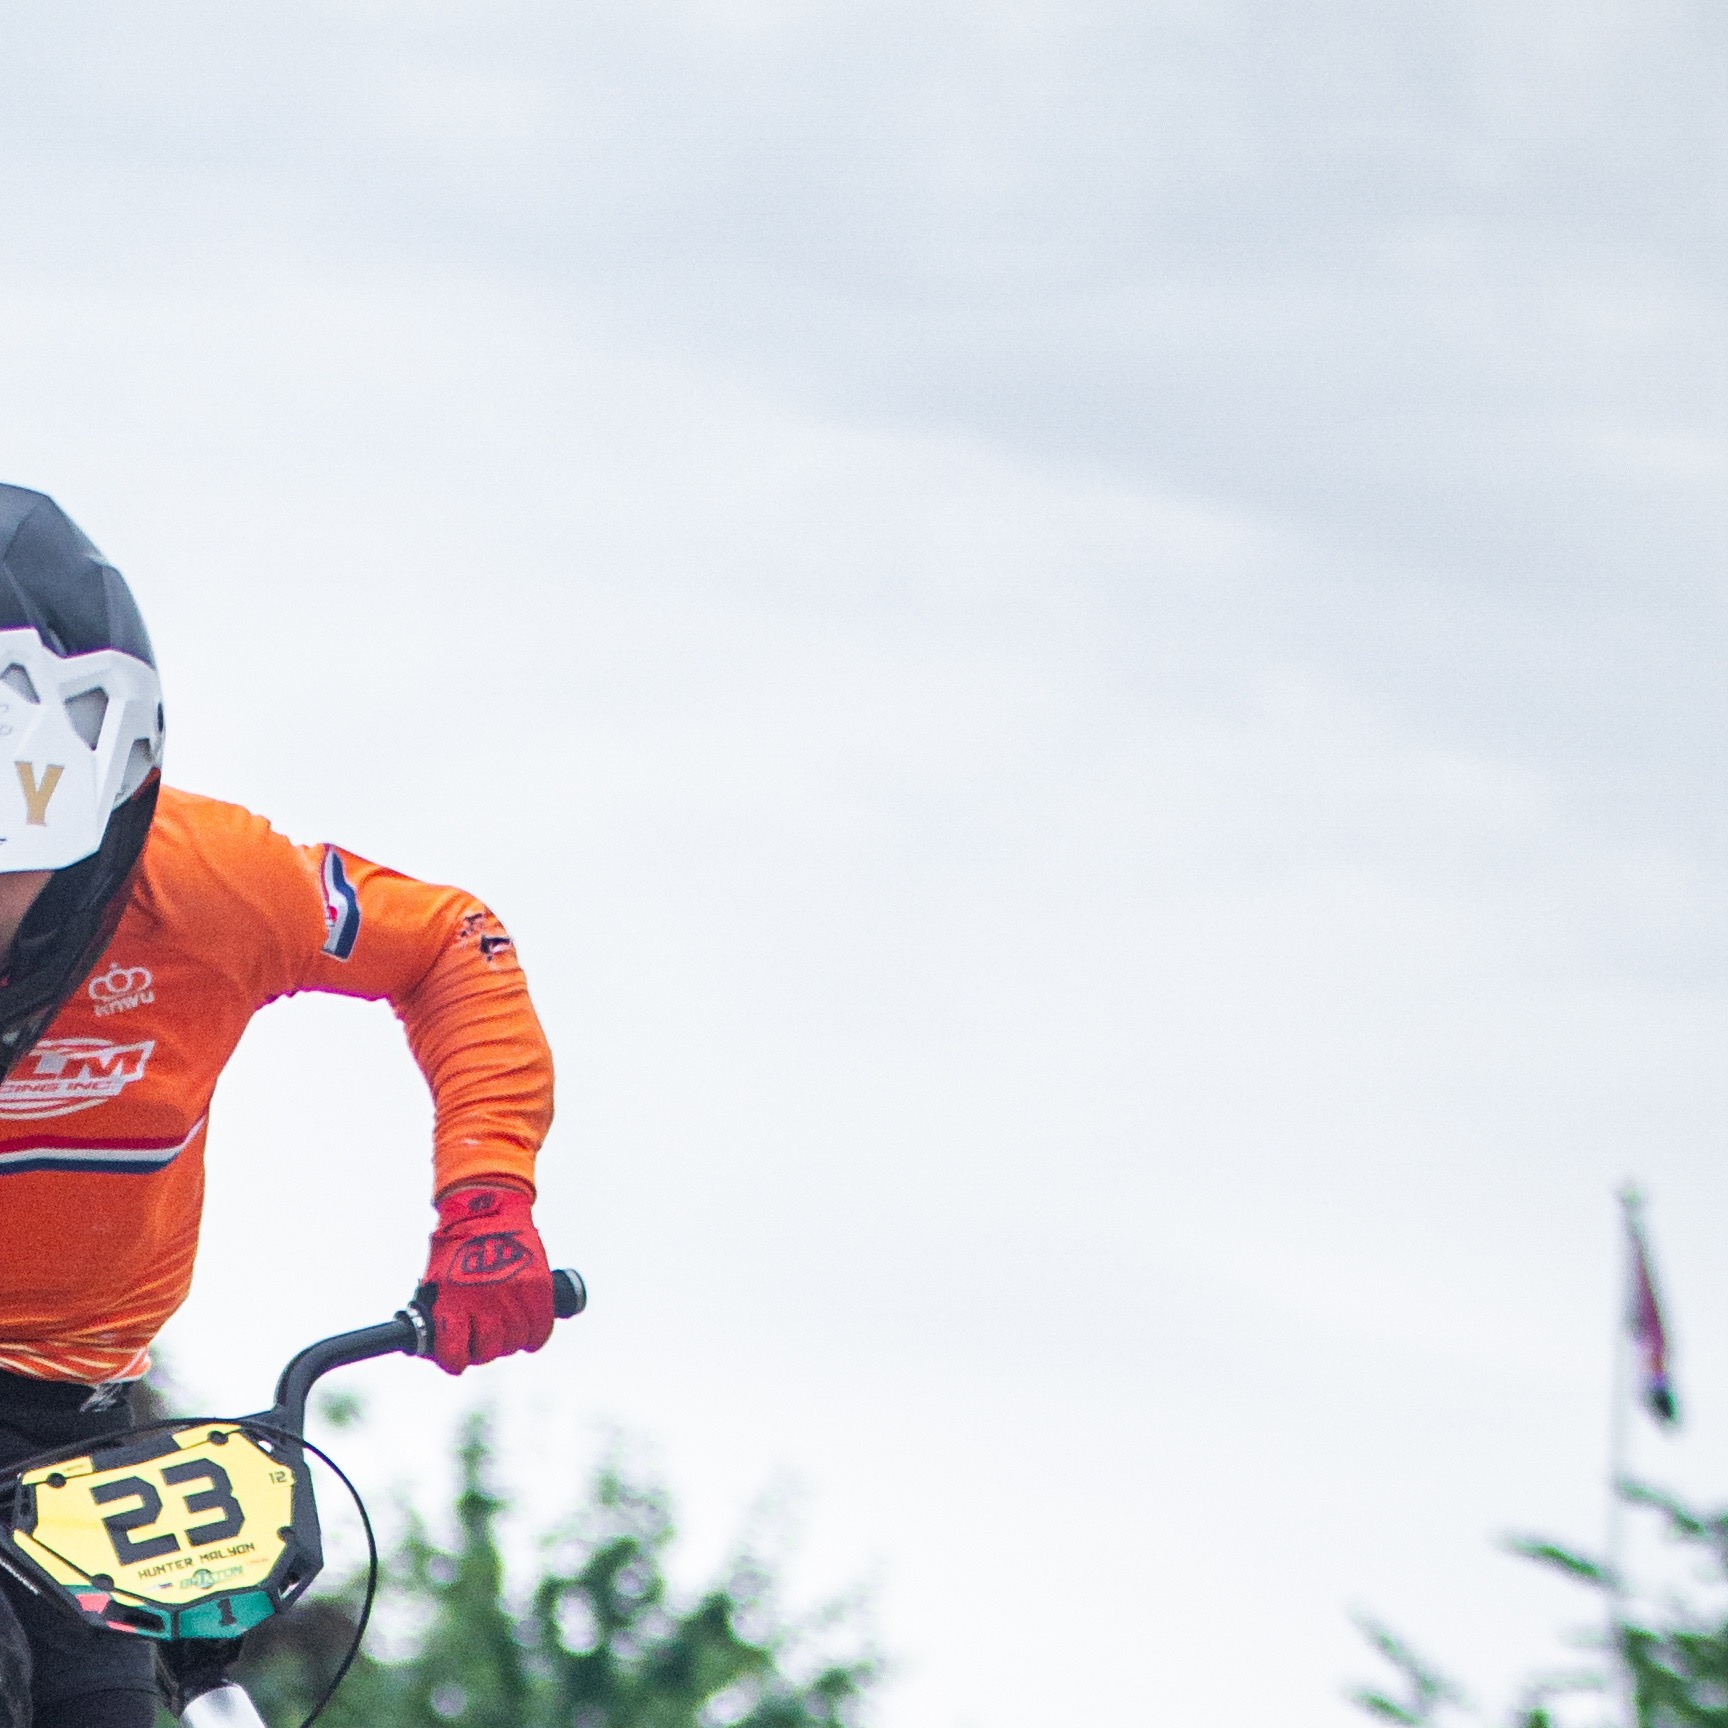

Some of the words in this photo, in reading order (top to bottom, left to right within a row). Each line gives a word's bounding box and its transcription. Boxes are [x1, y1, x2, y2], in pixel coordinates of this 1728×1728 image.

[268, 1470, 287, 1485] 12
[89, 1457, 246, 1567] 23
[137, 1556, 194, 1580] HUNTER
[198, 1542, 256, 1564] MALYON
